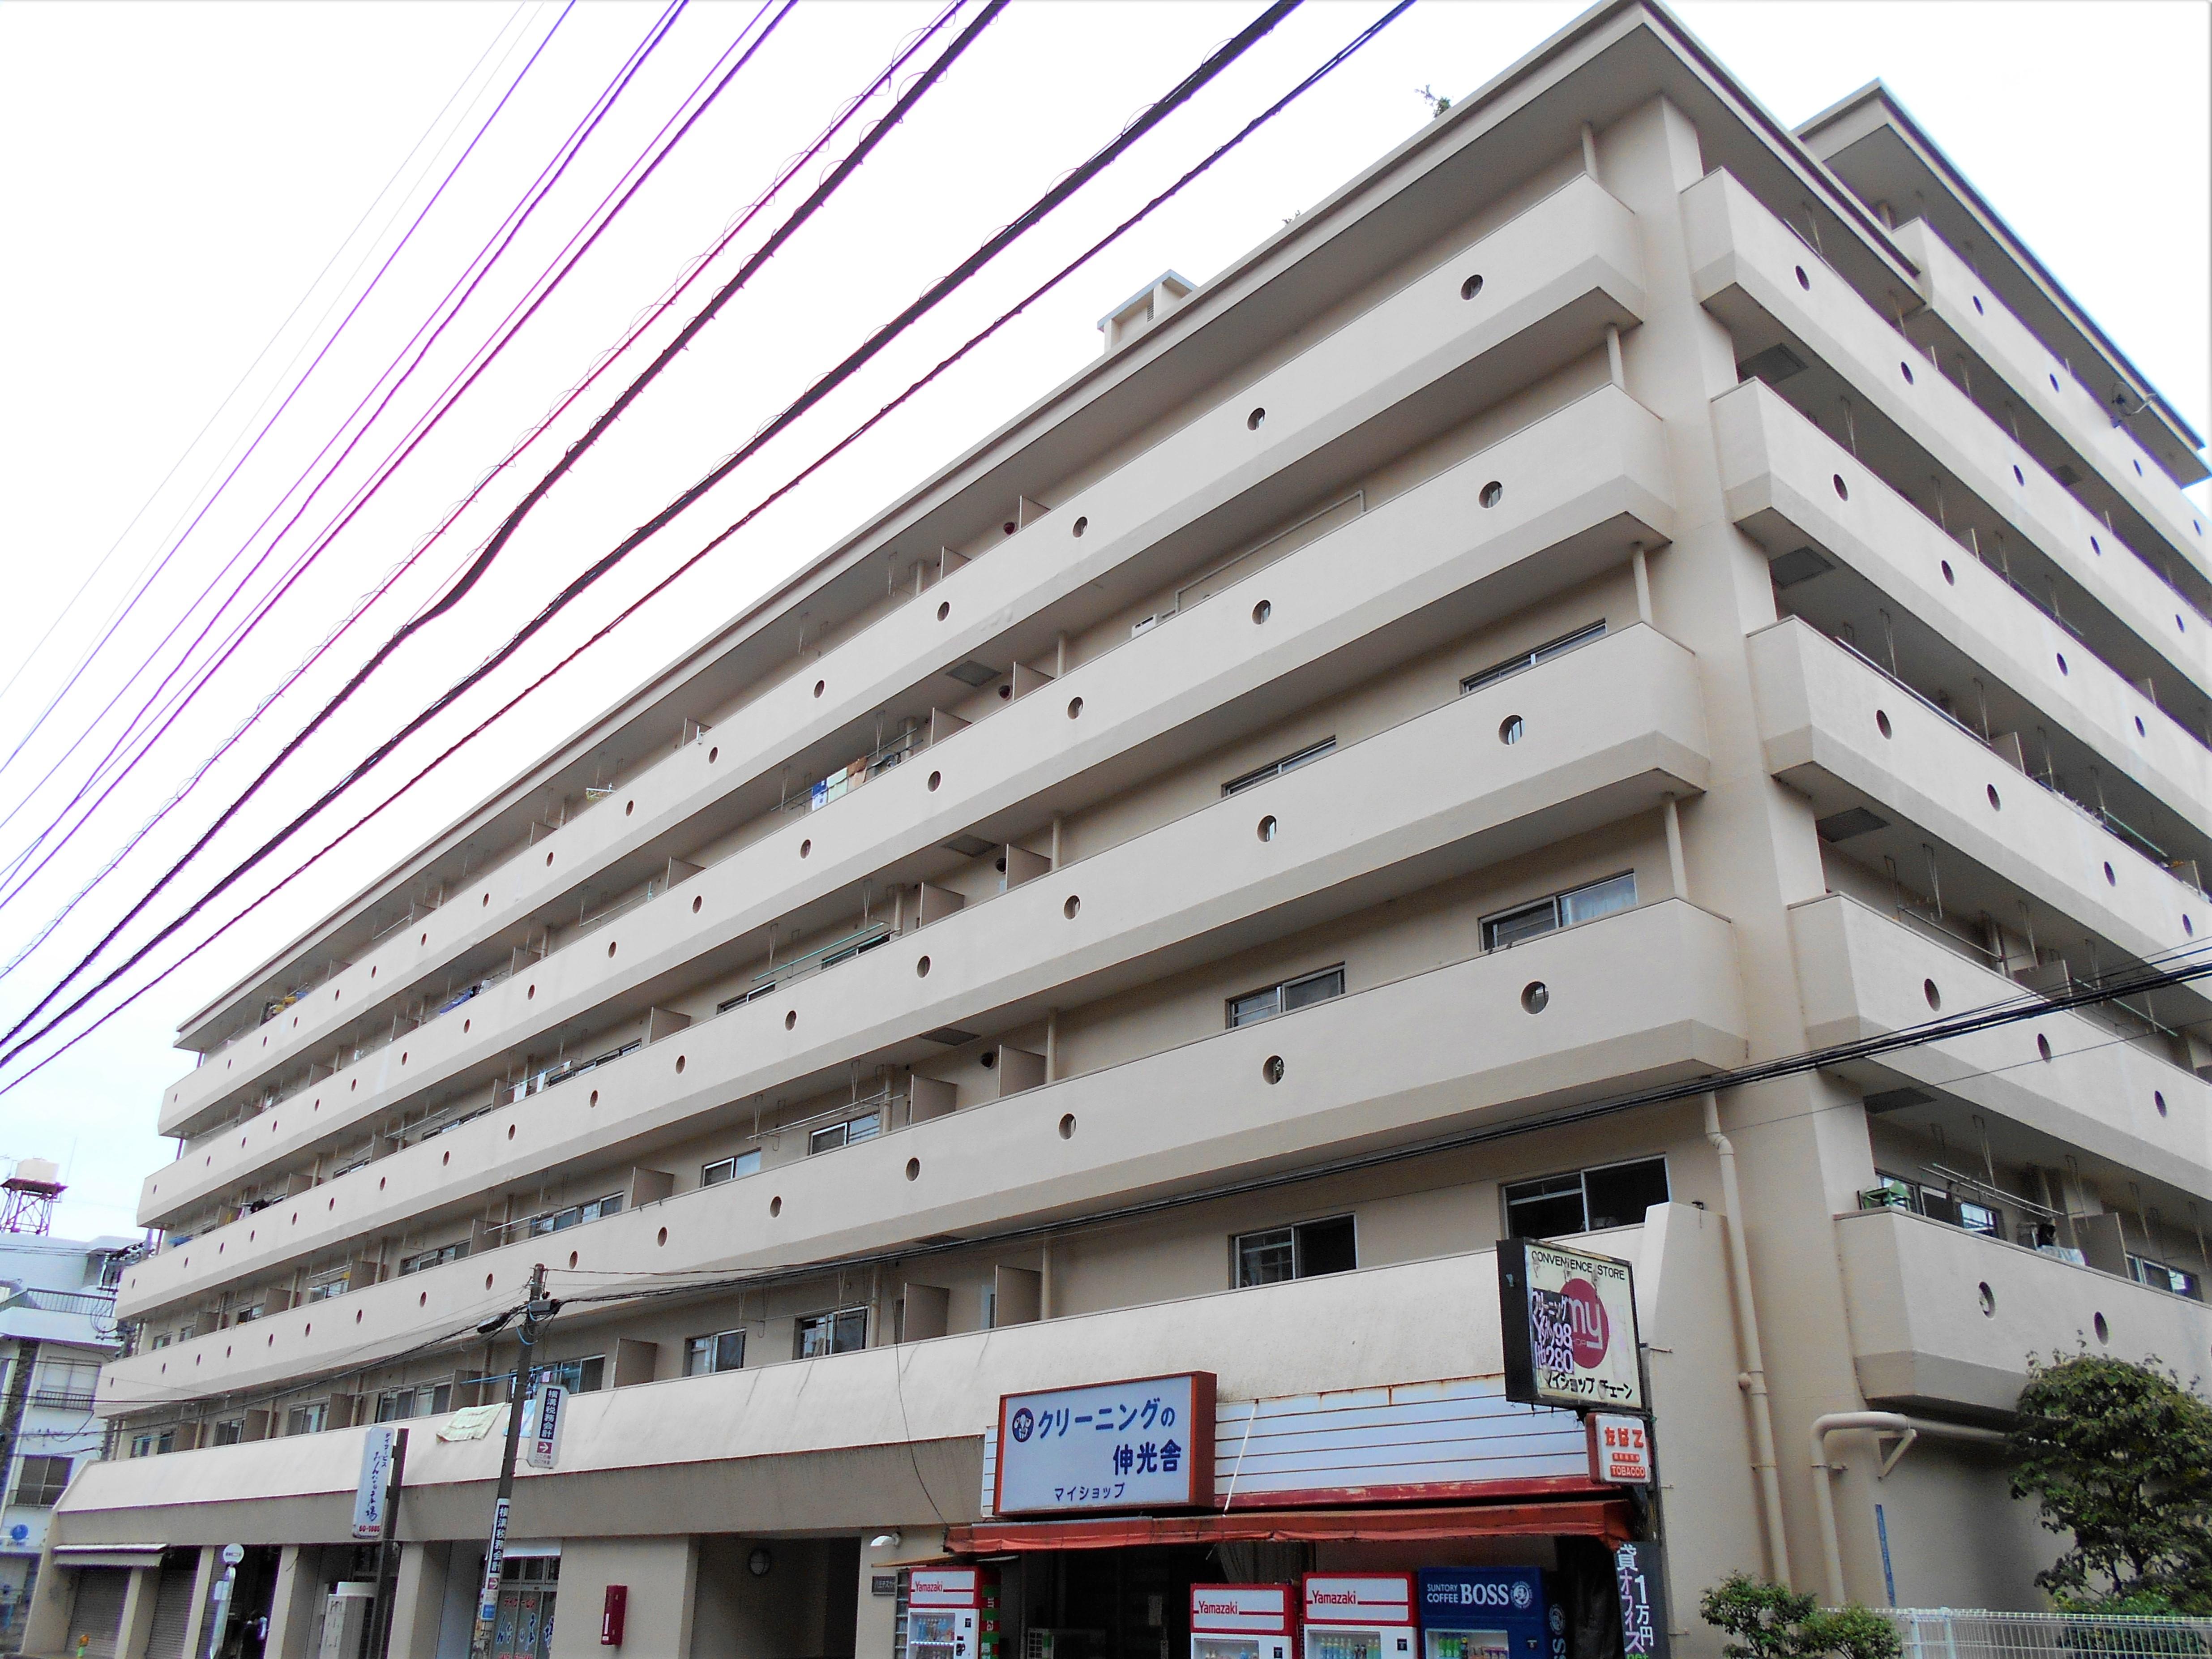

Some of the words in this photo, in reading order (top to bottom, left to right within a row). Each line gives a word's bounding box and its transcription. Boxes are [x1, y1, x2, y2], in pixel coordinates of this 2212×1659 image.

[1532, 1251, 1592, 1273] CONVENIENCE
[1597, 1265, 1625, 1280] STORE
[1546, 1372, 1595, 1394] イショップ
[1039, 1397, 1175, 1439] クリーニングの
[1605, 1427, 1644, 1448] たばこ
[1113, 1439, 1181, 1476] 伸光舎
[1612, 1466, 1645, 1476] TOBACCO
[1054, 1482, 1125, 1502] マイショップ
[915, 1581, 943, 1592] Yamazaki
[1312, 1590, 1357, 1604] Yamazaki
[1427, 1584, 1458, 1592] SUNTORY
[1460, 1583, 1509, 1605] BOSS
[1198, 1600, 1238, 1615] Yamazaki
[1427, 1593, 1459, 1603] COFFEE
[1617, 1544, 1645, 1653] 貸オフィス
[1634, 1574, 1654, 1646] 1万円
